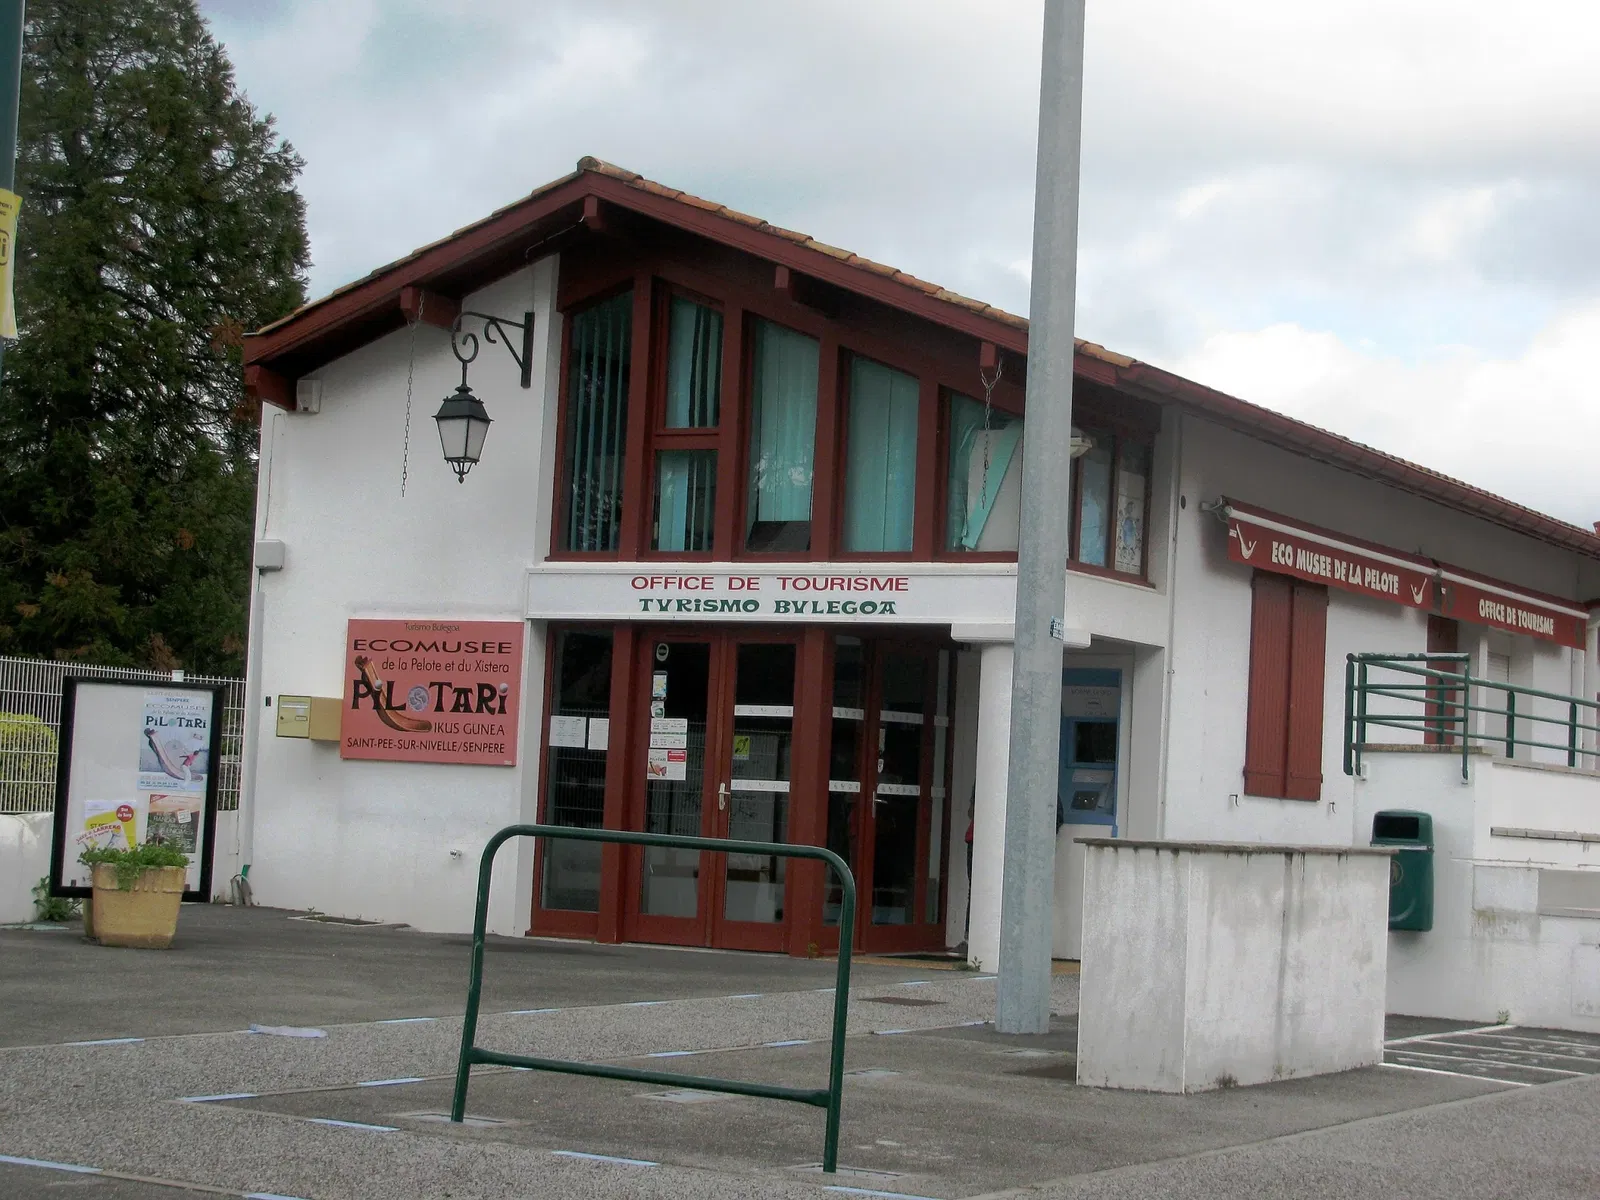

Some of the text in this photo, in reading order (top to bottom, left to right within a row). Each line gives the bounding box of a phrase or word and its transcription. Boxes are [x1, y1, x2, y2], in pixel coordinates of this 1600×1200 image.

[1272, 541, 1399, 595] ECO MUSEE DE LA PELOTE
[631, 575, 909, 592] OFFICE DE TOURISME
[1479, 599, 1554, 635] OFFICE DE TOURISME
[404, 623, 431, 632] Turismo
[353, 639, 512, 654] ECOMUSEE
[382, 656, 509, 673] de la Pelote et du Xistera
[434, 722, 505, 735] IKUS GUNEA
[347, 737, 505, 753] SAINT-PEE-SUR-NIVELLE/SENPERE
